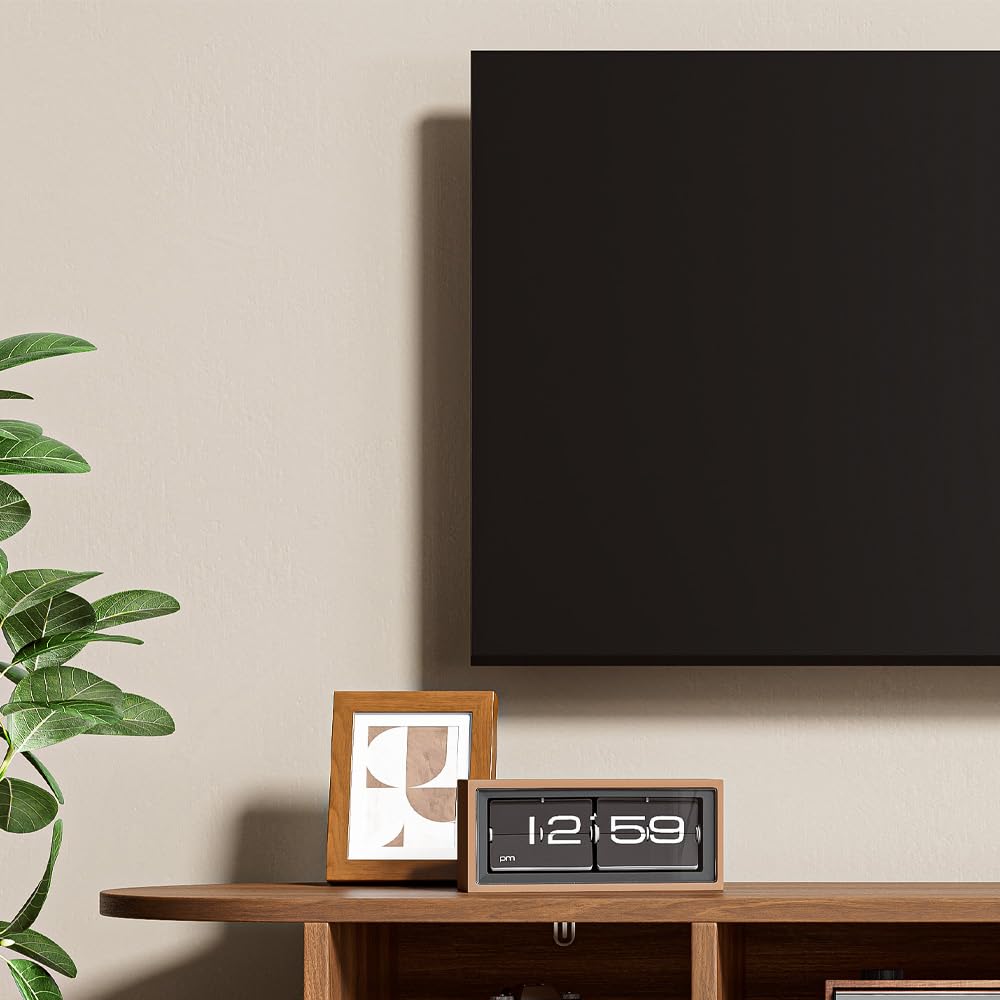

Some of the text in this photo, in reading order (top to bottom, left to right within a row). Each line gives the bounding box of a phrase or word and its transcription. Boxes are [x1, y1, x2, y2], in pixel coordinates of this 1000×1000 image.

[528, 815, 685, 845] 12 59
[499, 855, 516, 863] pm
